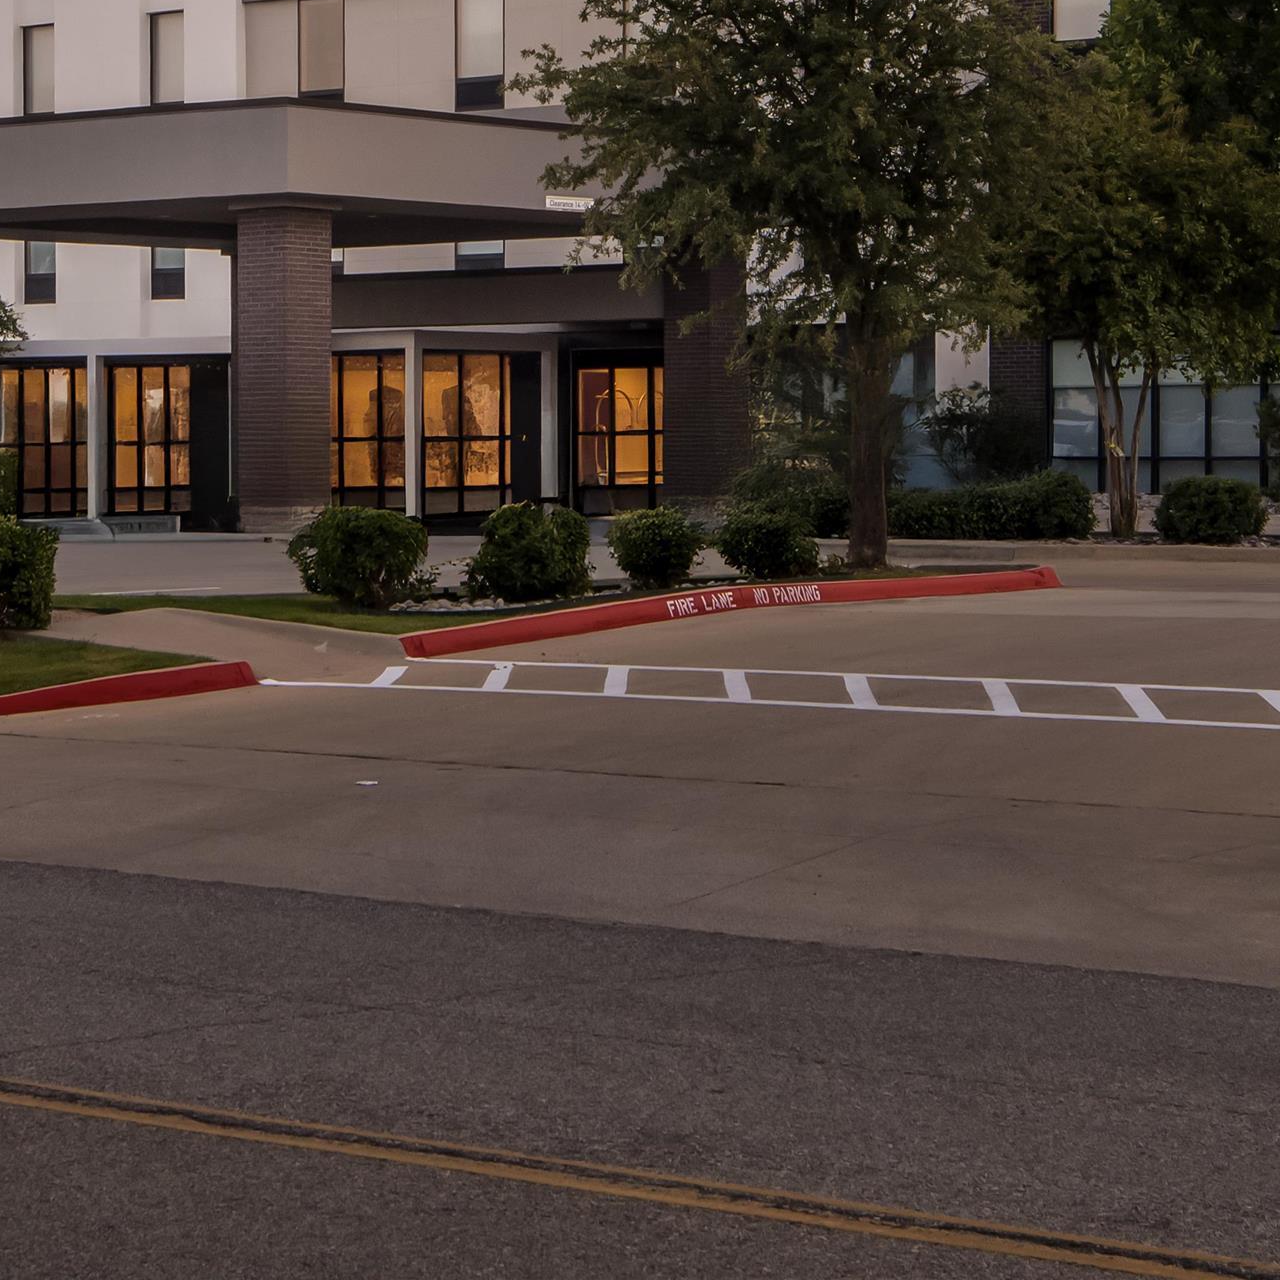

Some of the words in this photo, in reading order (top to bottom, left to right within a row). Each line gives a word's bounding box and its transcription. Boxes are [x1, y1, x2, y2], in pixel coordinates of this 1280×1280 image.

[666, 597, 698, 617] FIRE
[701, 591, 737, 611] LANE
[752, 588, 770, 605] NO
[773, 584, 821, 604] PARKING
